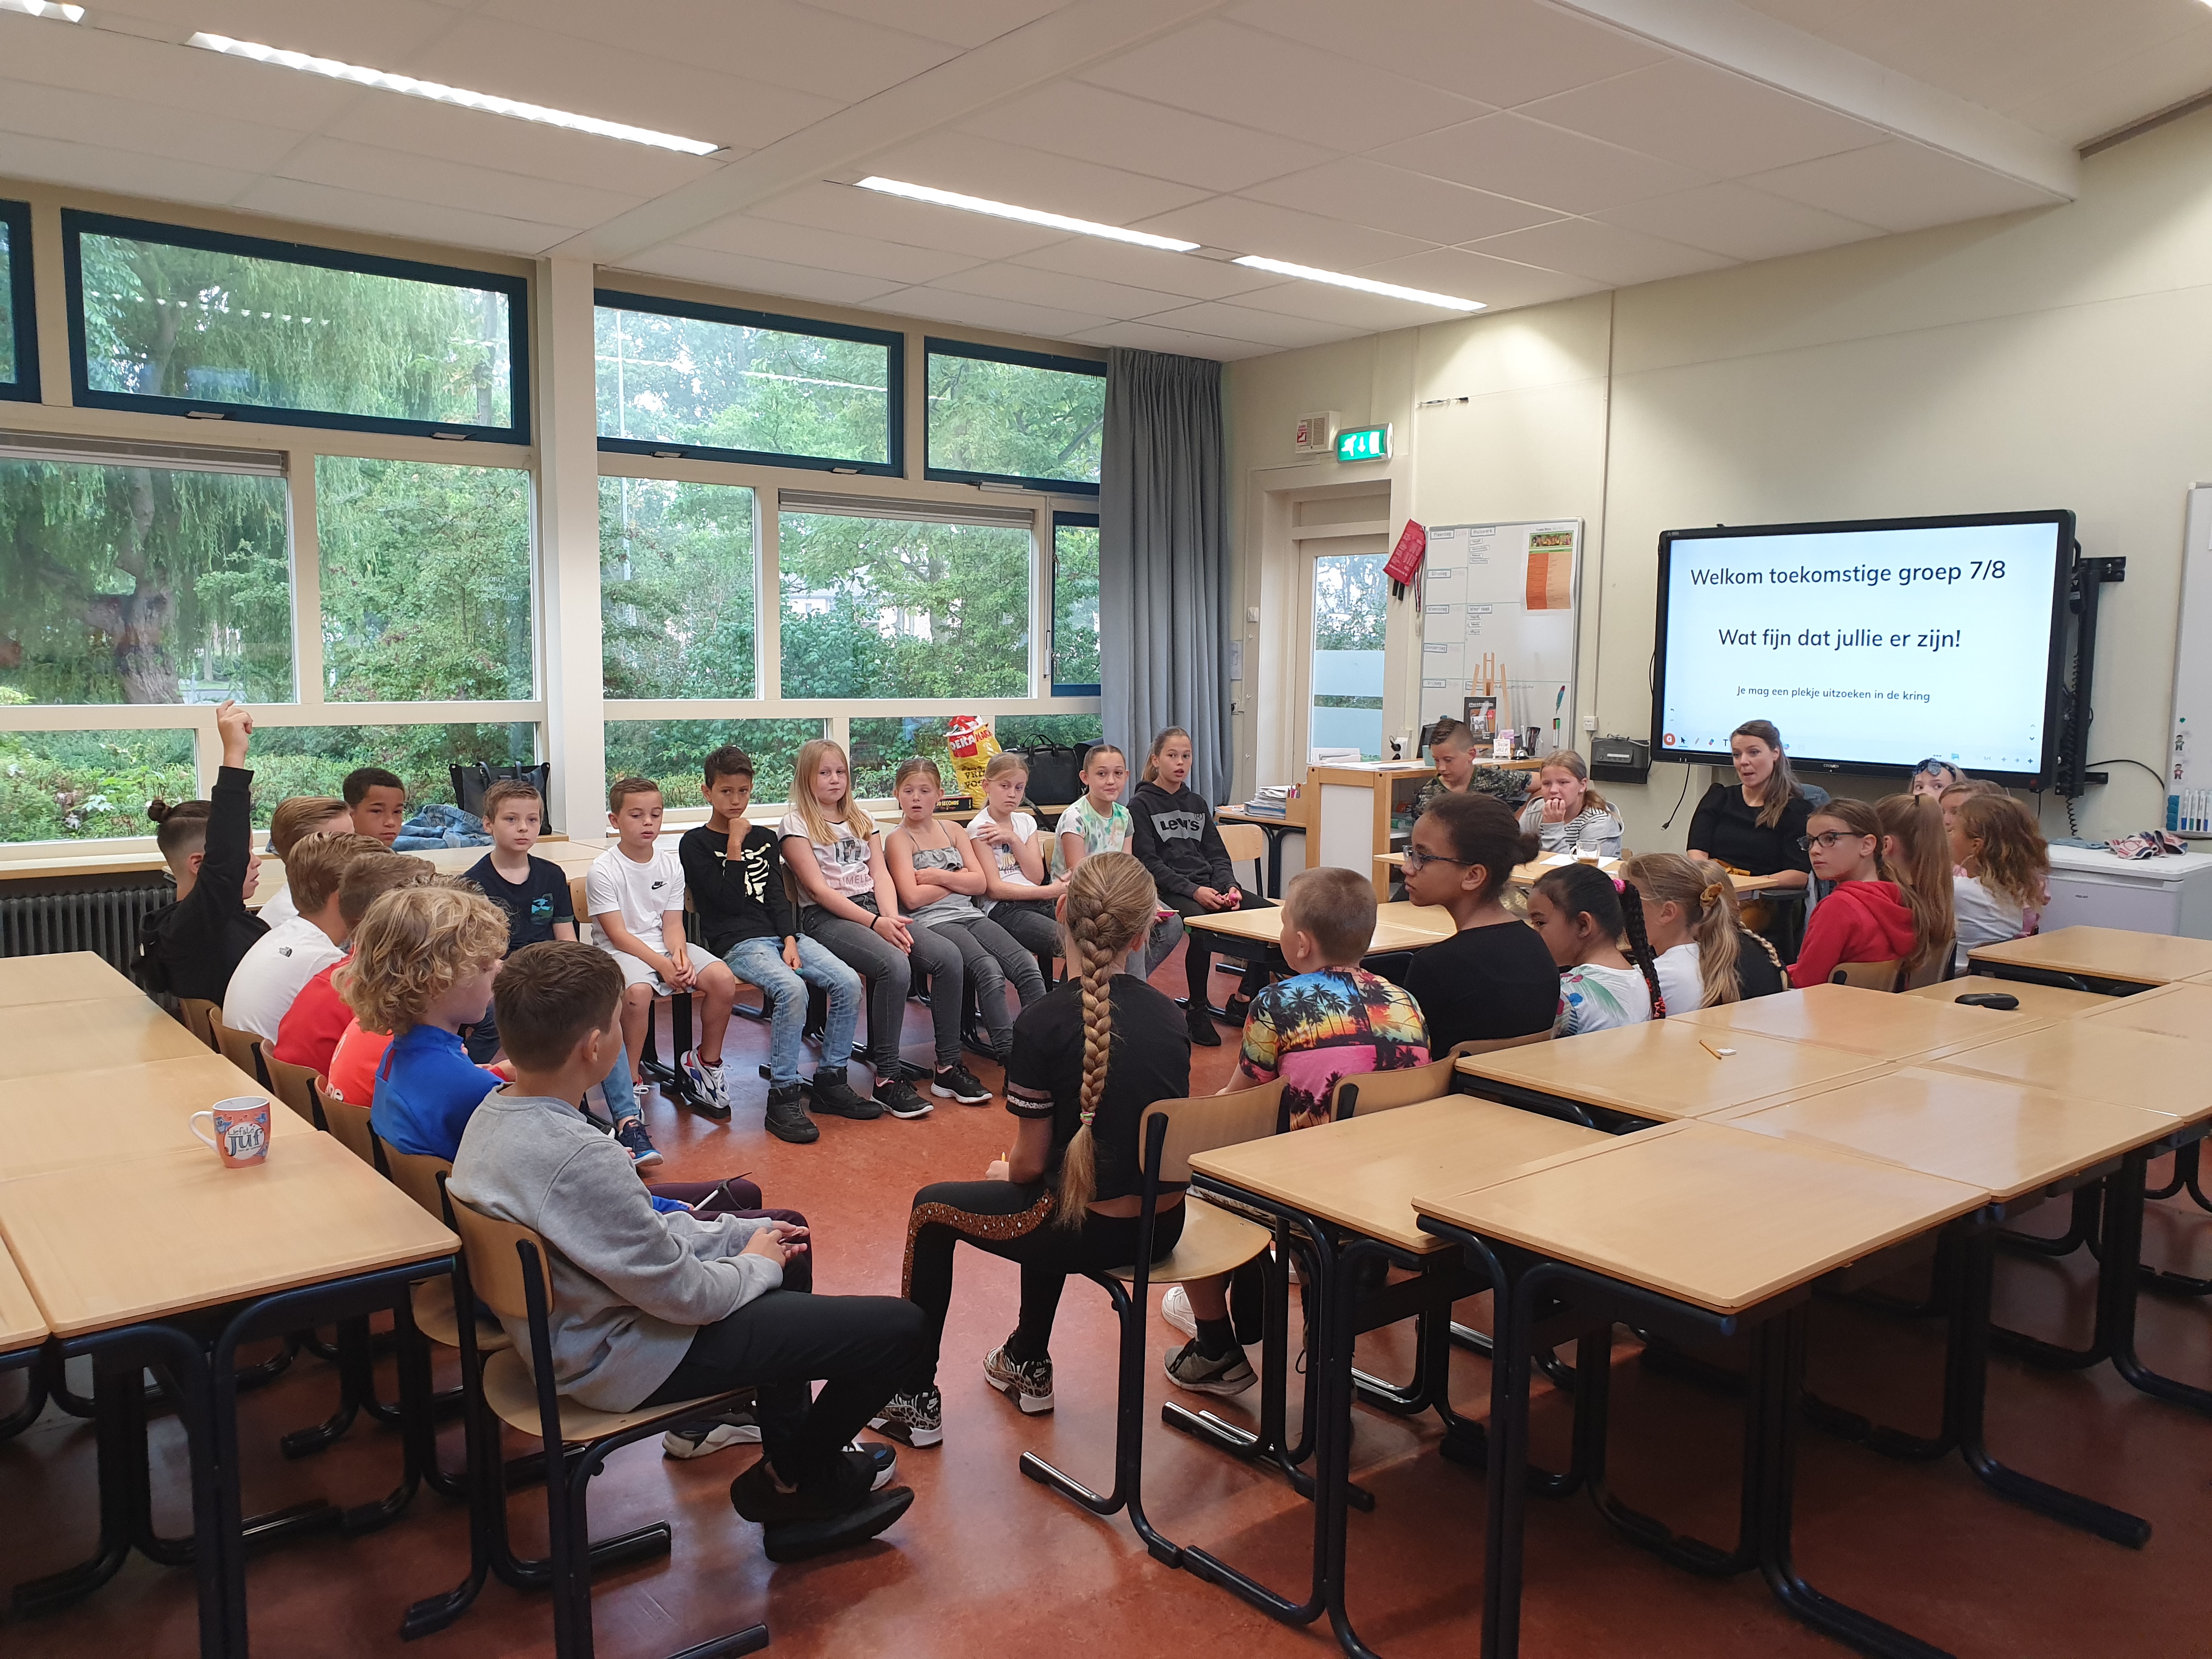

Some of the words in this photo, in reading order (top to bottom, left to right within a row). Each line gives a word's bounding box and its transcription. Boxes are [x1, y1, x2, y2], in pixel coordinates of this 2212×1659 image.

[1691, 568, 1763, 585] Welkom
[1769, 565, 1892, 586] toekomstige
[1899, 567, 1961, 585] groep
[1971, 560, 2006, 580] 7/8
[1719, 629, 1757, 646] Wat
[1763, 629, 1791, 650] fijn
[1798, 629, 1831, 646] dat
[1835, 629, 1883, 651] jullie
[1891, 634, 1911, 647] er
[1917, 629, 1961, 652] zijn!
[1737, 686, 1746, 696] Je
[1749, 688, 1769, 697] mag
[1791, 687, 1820, 699] plekje
[1823, 688, 1871, 698] uitzoeken
[1875, 690, 1883, 699] in
[1887, 690, 1899, 699] de
[1903, 690, 1930, 703] kring
[950, 735, 976, 751] DEKA
